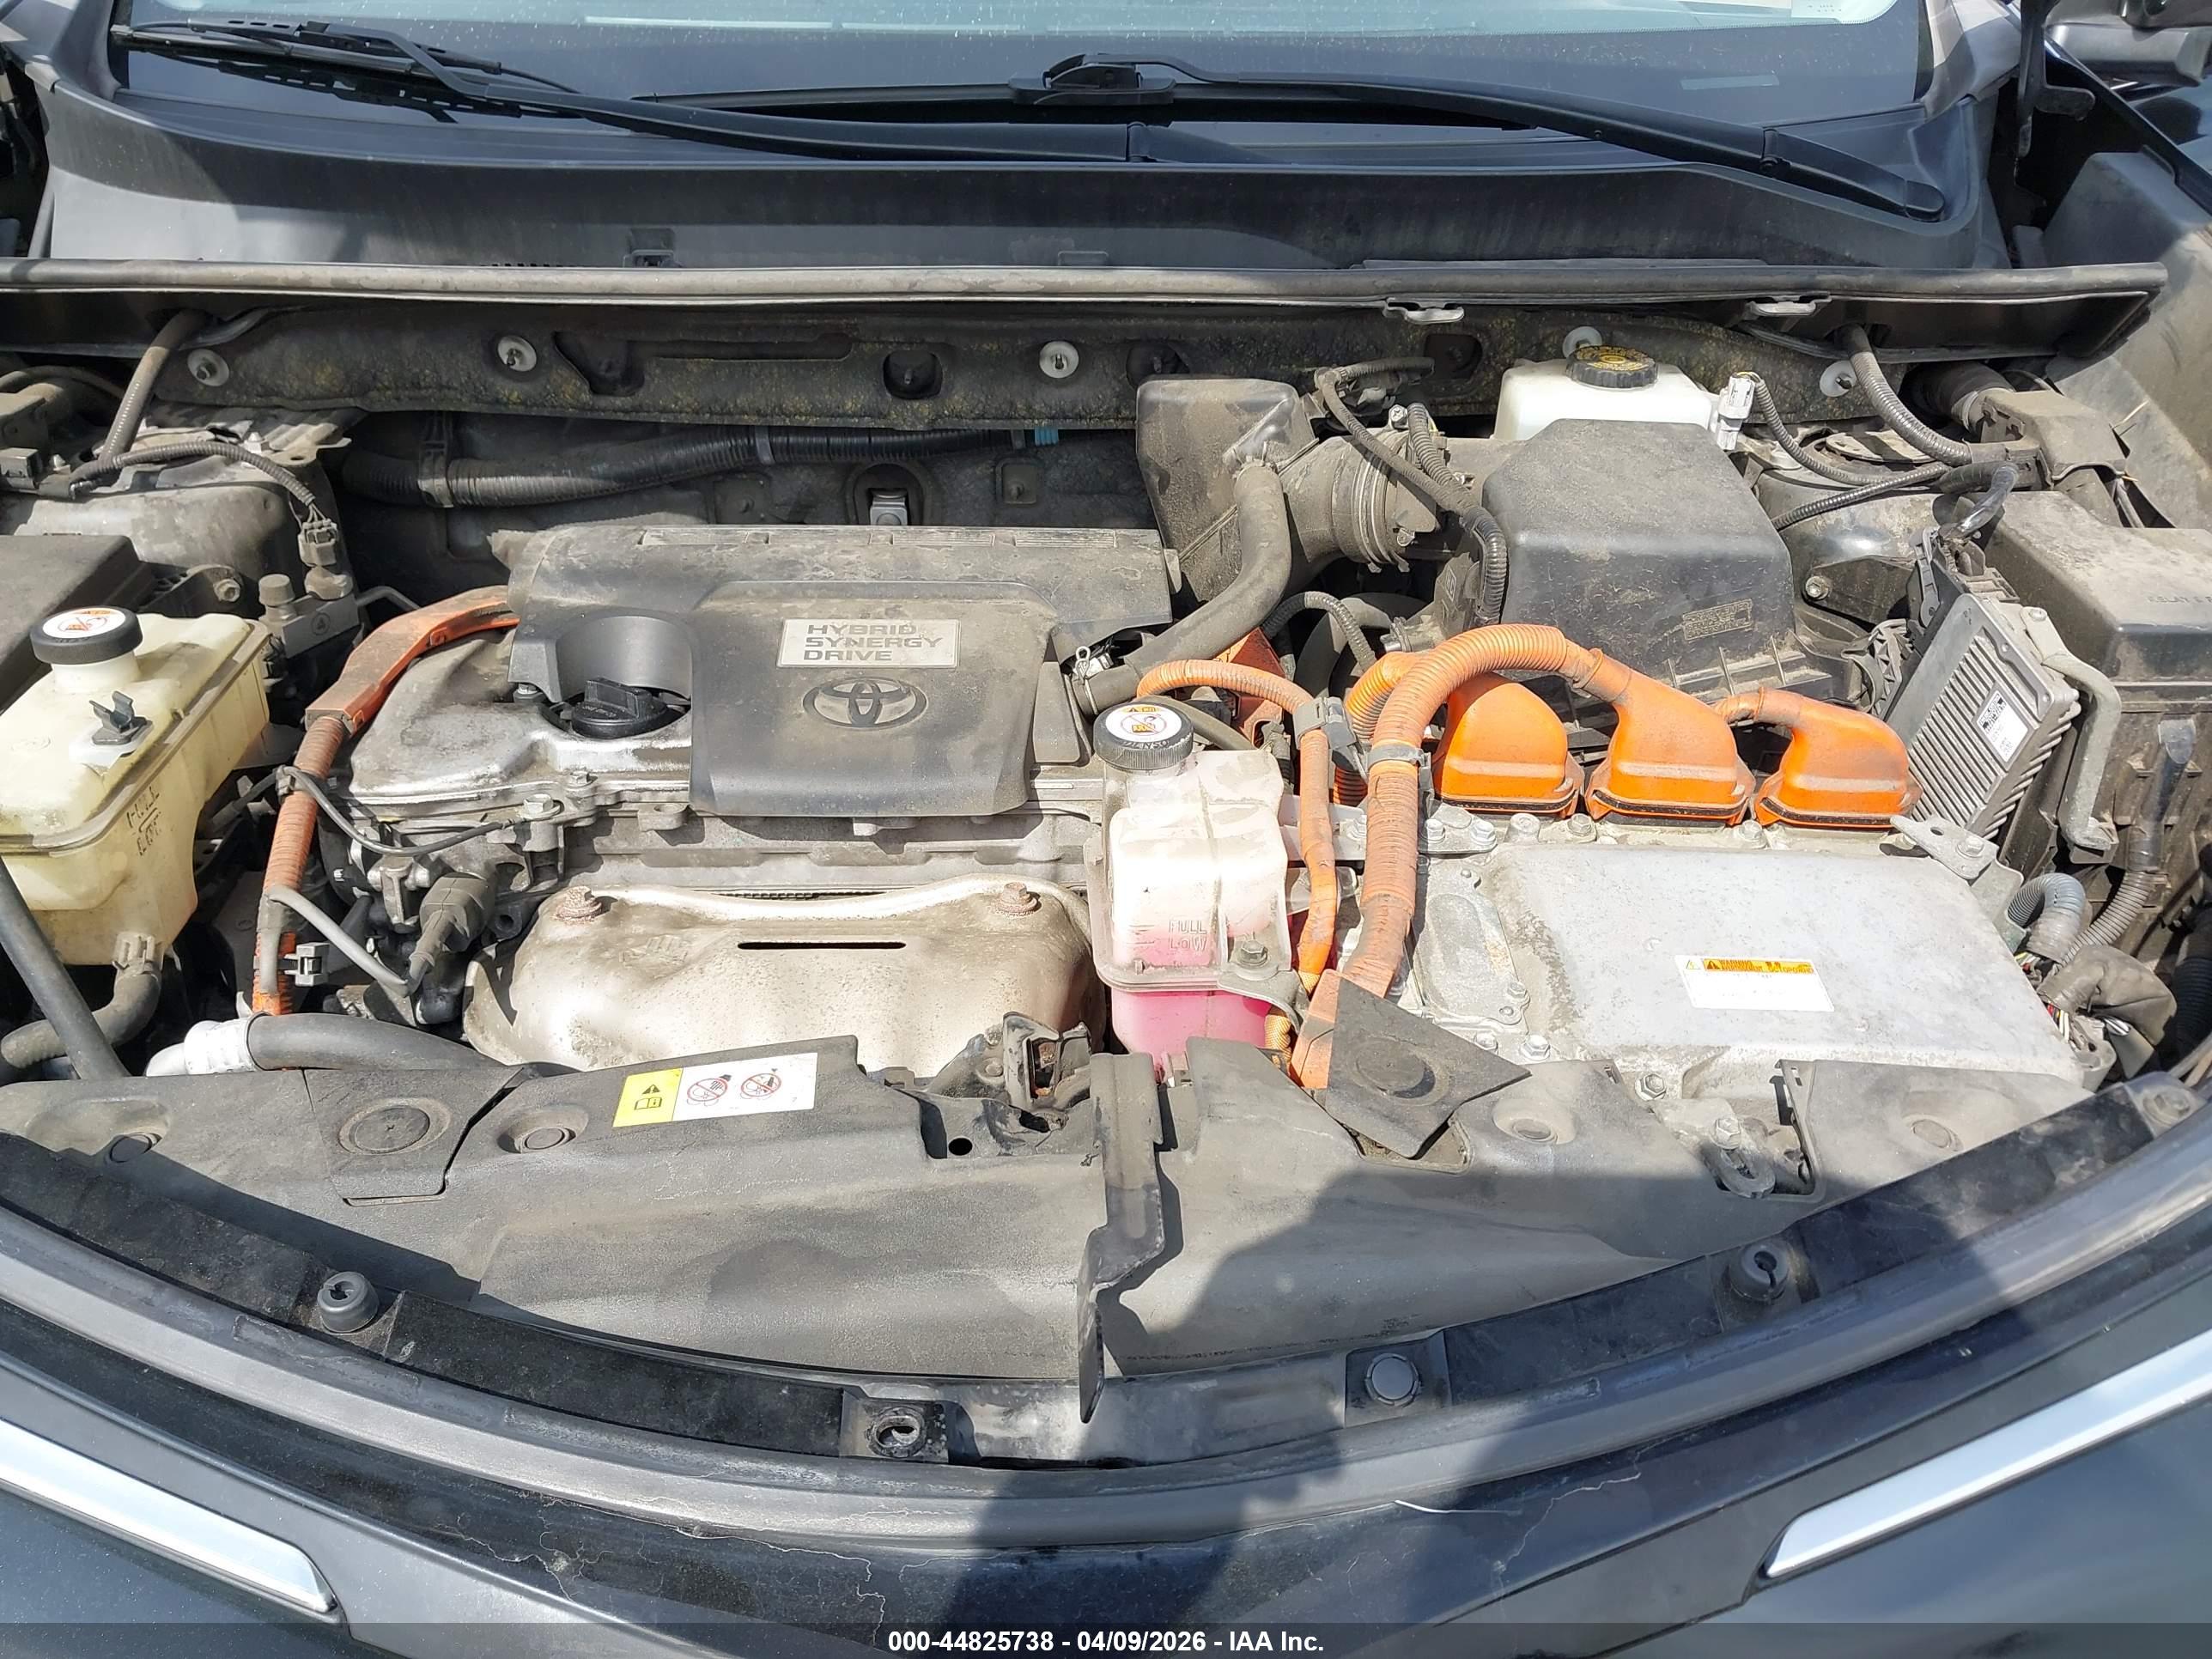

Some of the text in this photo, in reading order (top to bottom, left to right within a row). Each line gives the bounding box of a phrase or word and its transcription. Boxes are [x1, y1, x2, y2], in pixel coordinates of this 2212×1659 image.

[806, 623, 918, 635] HYBRID
[805, 636, 944, 647] SYNERGY
[803, 650, 893, 661] DRIVE
